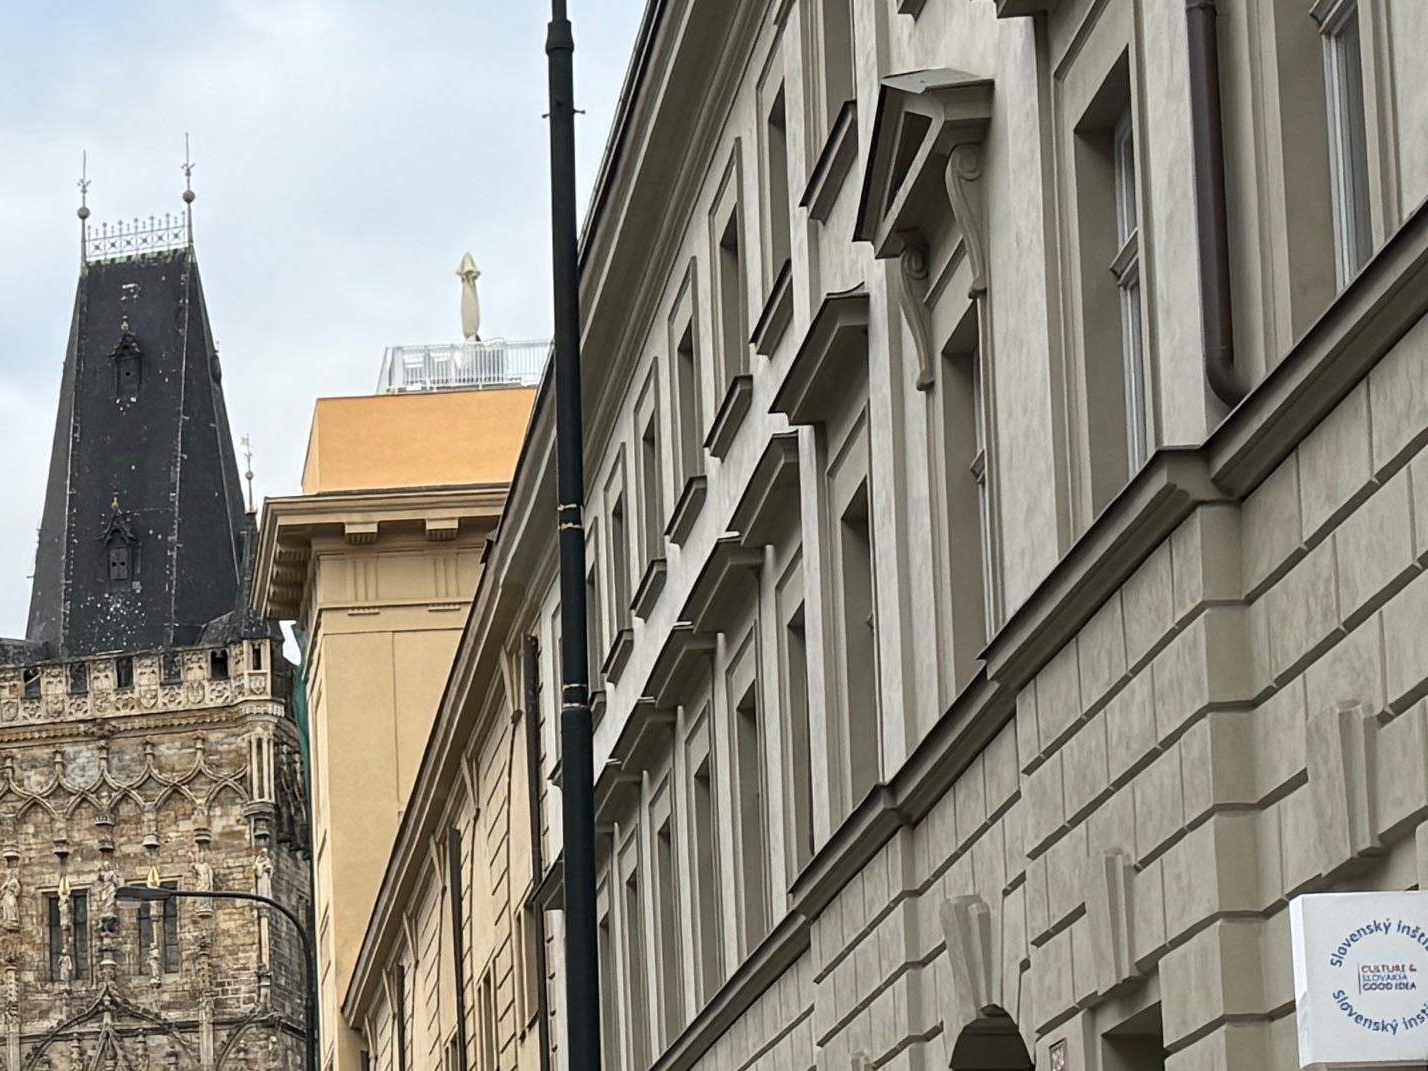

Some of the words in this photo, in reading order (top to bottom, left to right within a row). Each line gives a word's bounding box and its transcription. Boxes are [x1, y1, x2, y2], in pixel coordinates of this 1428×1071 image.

[1330, 918, 1392, 967] Slovenský
[1362, 982, 1393, 991] GOOD
[1332, 989, 1399, 1036] Slovenský
